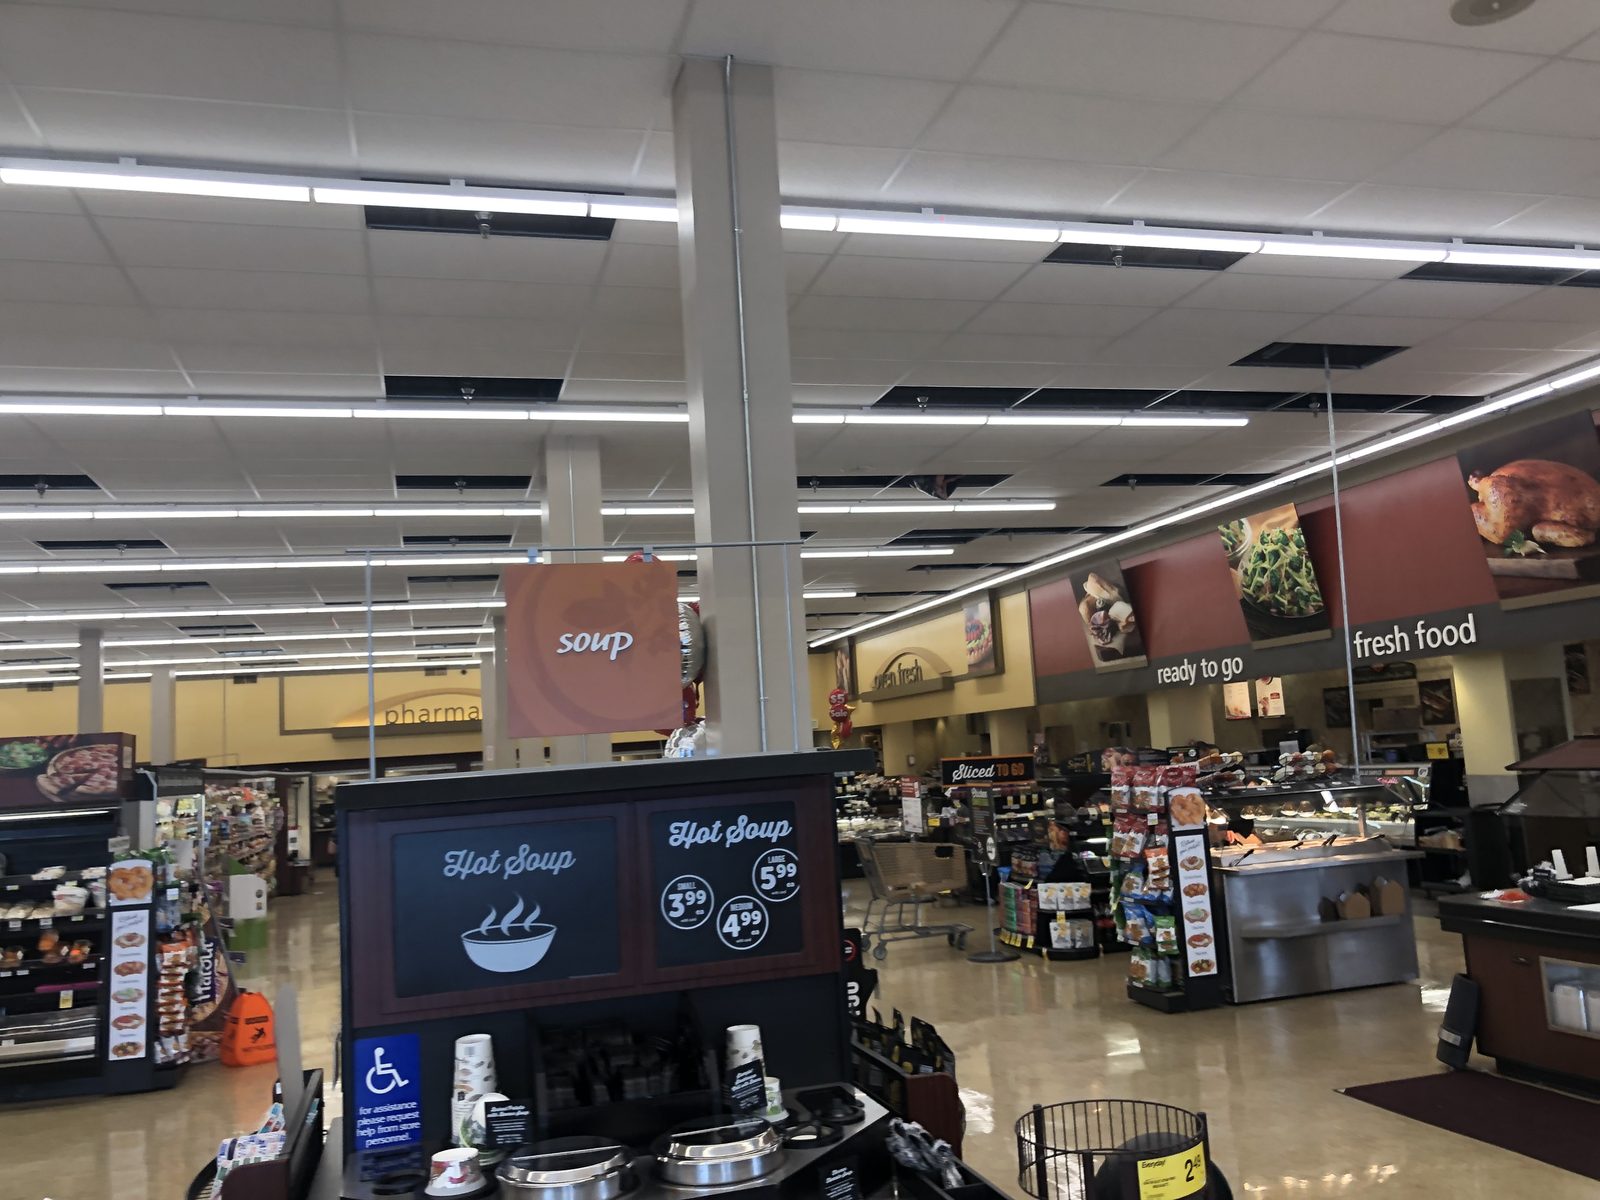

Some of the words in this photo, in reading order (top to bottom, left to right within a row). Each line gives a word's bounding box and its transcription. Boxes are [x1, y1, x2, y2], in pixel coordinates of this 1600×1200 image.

[556, 631, 634, 661] soup
[1353, 624, 1411, 659] fresh
[1414, 612, 1477, 650] food
[897, 658, 924, 687] fresh
[1157, 658, 1197, 686] ready
[1200, 658, 1218, 678] to
[1221, 657, 1244, 682] go
[384, 703, 481, 725] pharma
[952, 763, 996, 783] Sliced
[995, 763, 1009, 777] TO
[1011, 762, 1025, 776] GO
[669, 820, 723, 849] Hot
[725, 814, 793, 848] Soup
[443, 849, 501, 880] Hot
[503, 843, 577, 880] Soup
[357, 1116, 386, 1128] please
[386, 1111, 420, 1122] request
[359, 1106, 373, 1115] for
[373, 1101, 417, 1113] assistance
[356, 1127, 376, 1137] help
[377, 1125, 399, 1134] from
[399, 1121, 421, 1131] store
[365, 1132, 412, 1149] personnel.
